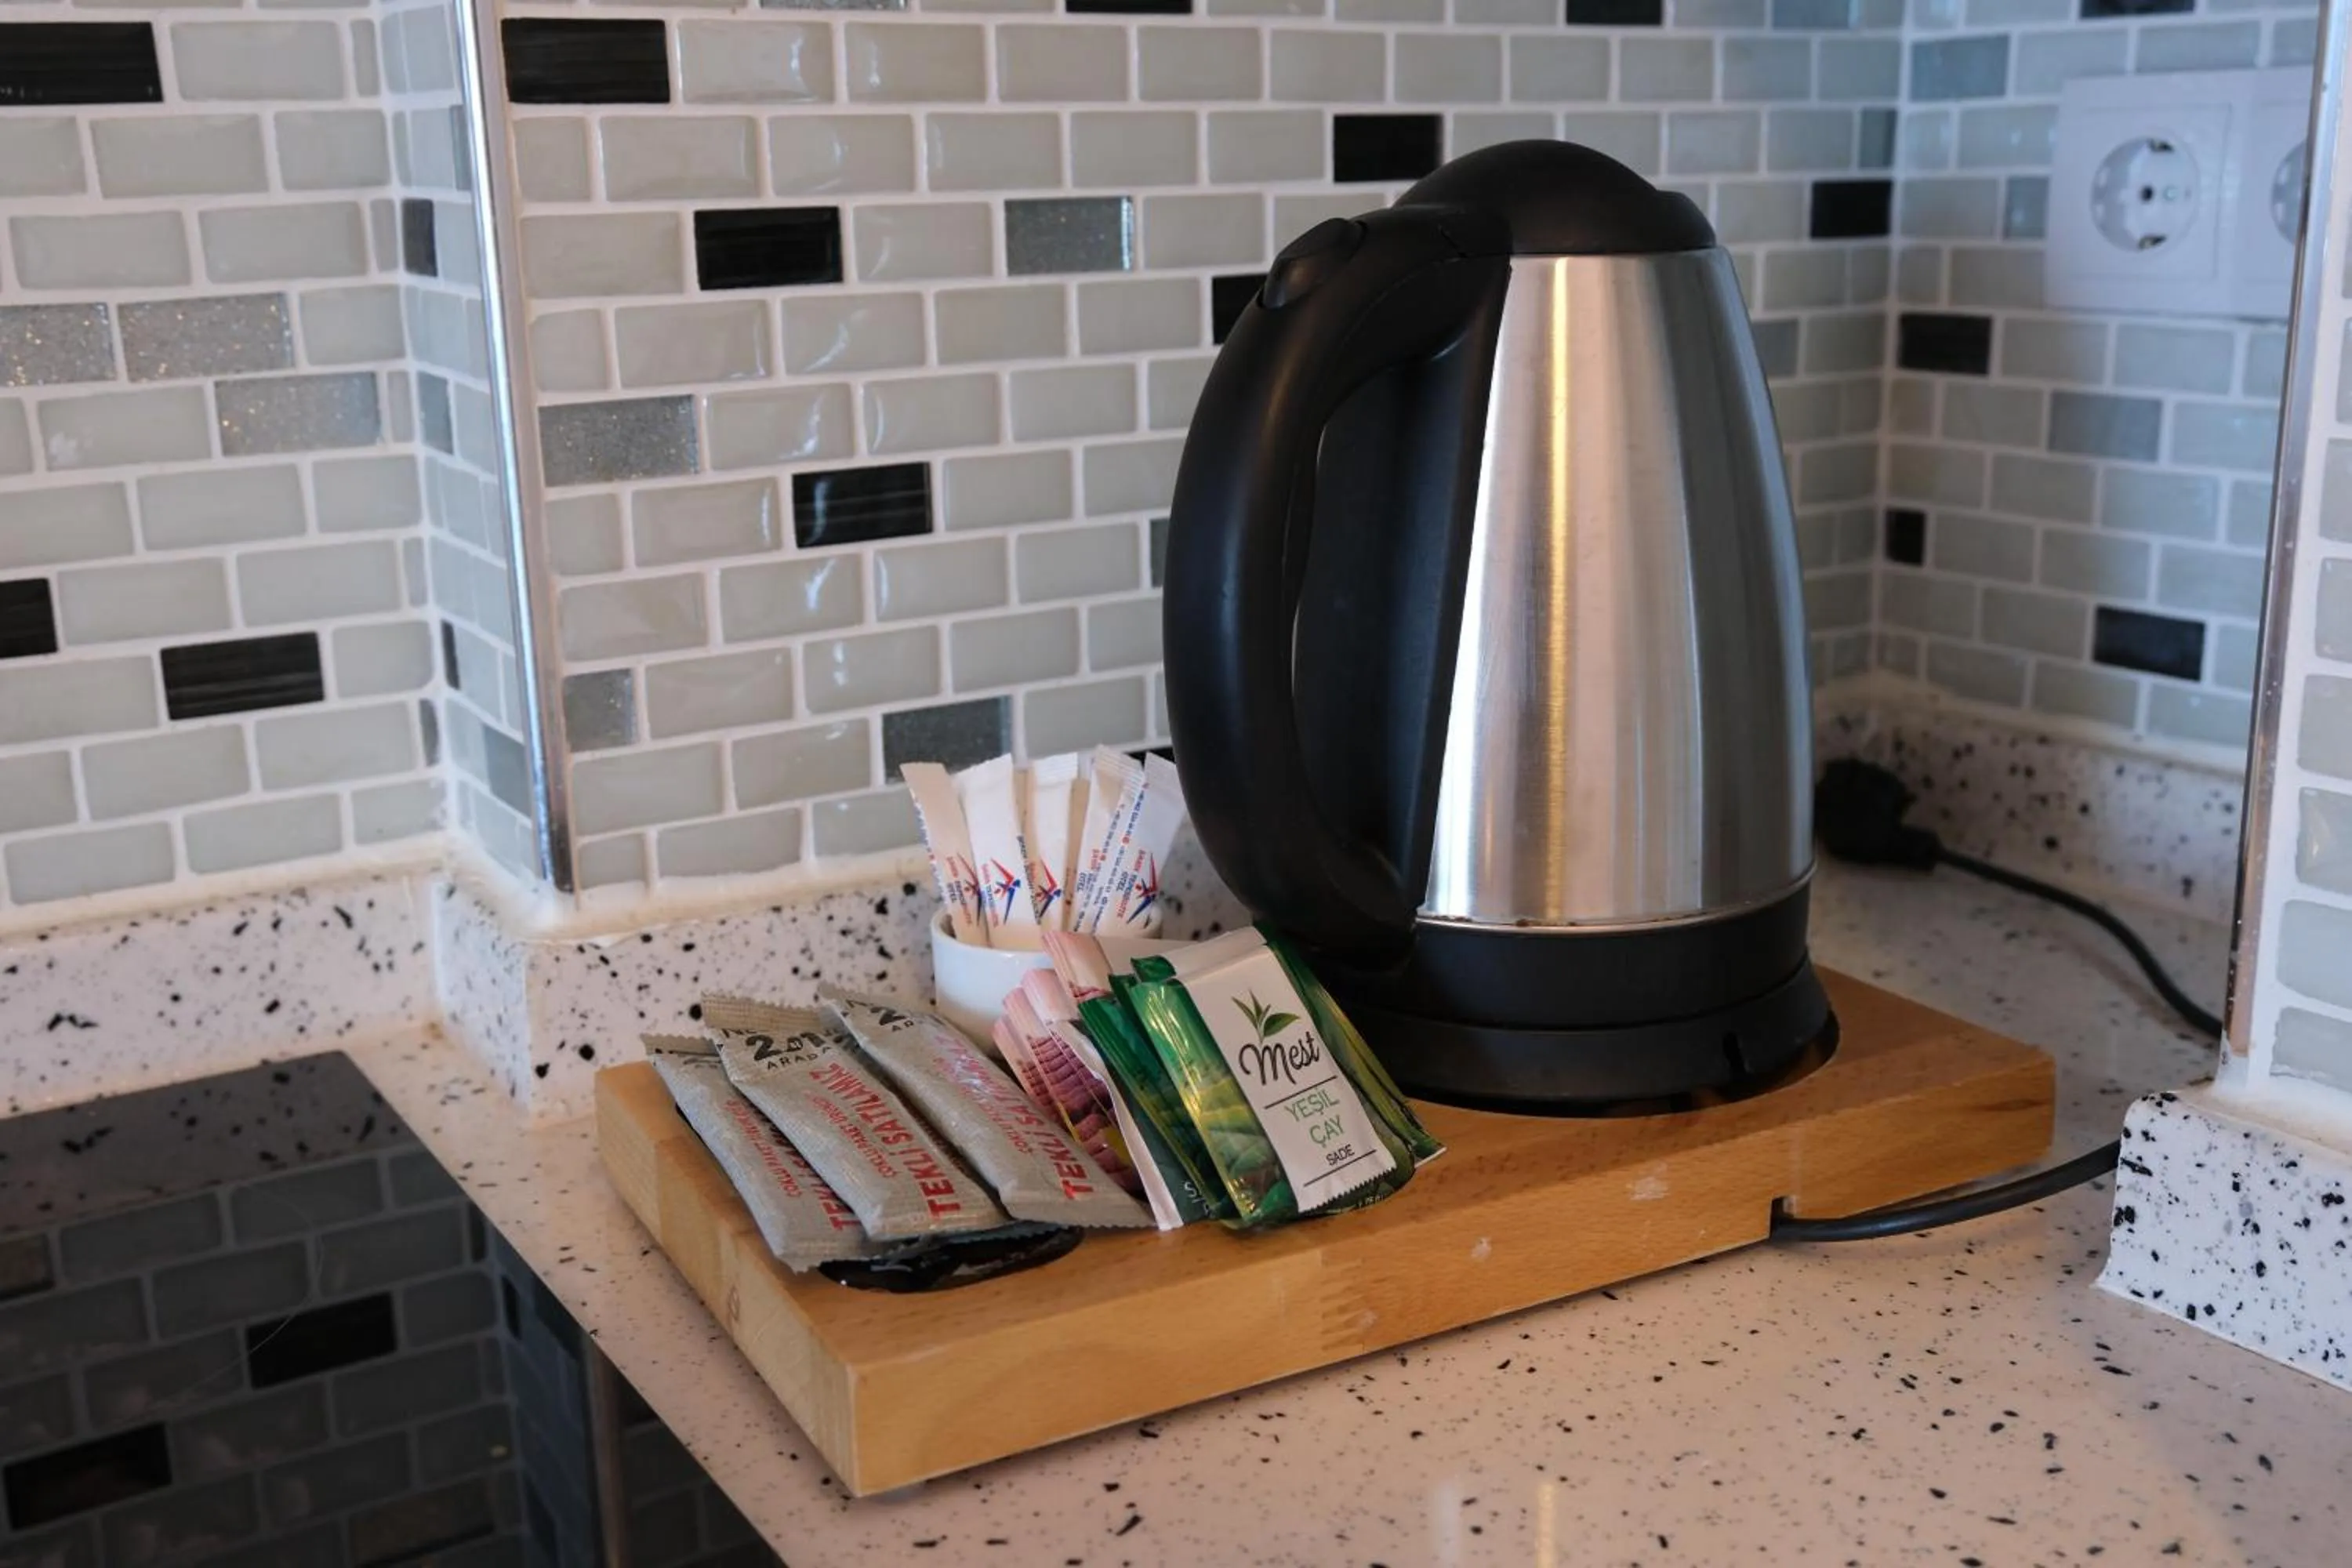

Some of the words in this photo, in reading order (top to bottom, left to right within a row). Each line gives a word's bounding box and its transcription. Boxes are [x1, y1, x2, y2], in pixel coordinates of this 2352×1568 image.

[1238, 1031, 1320, 1086] Mest
[1309, 1114, 1345, 1149] ÇAY
[1326, 1144, 1356, 1166] SADE
